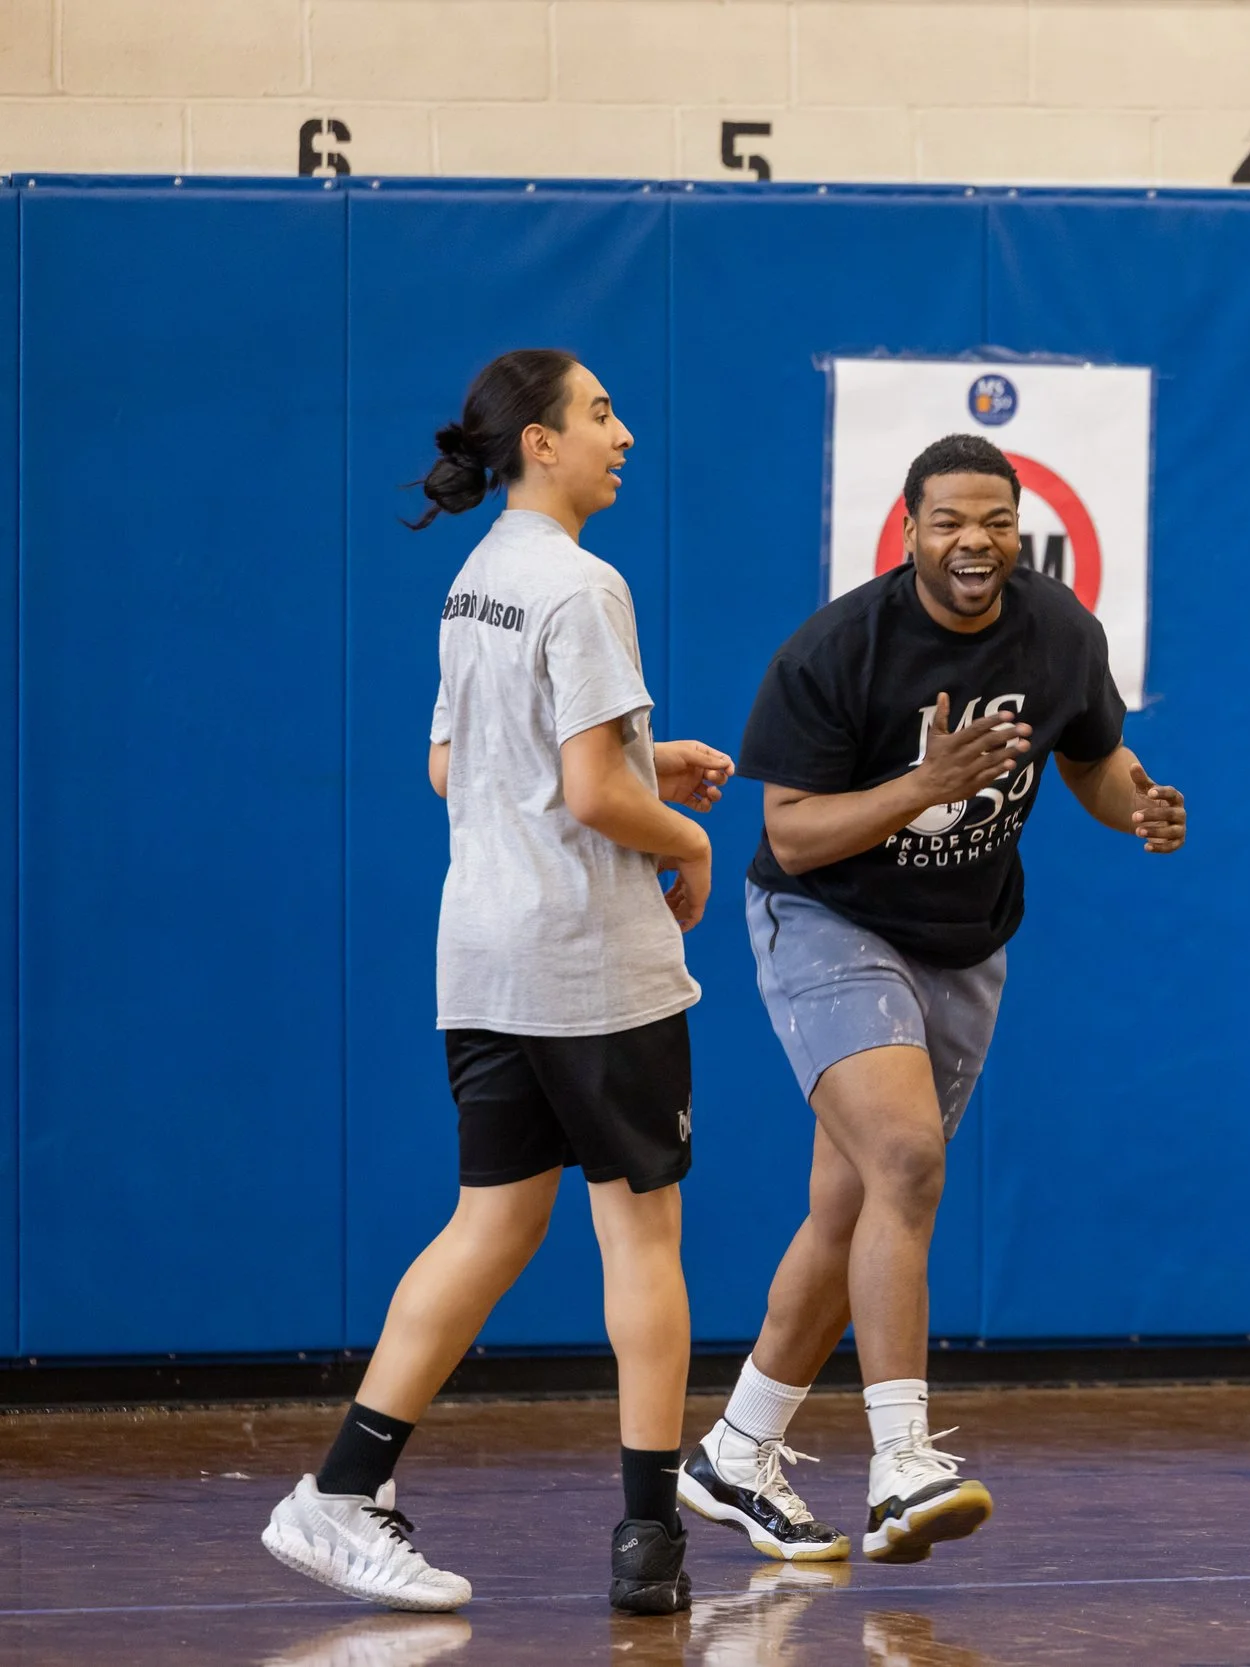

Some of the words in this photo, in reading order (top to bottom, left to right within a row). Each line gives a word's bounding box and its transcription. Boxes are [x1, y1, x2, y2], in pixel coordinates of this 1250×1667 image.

[299, 119, 351, 177] 6
[721, 121, 771, 182] 5
[970, 823, 998, 843] OF
